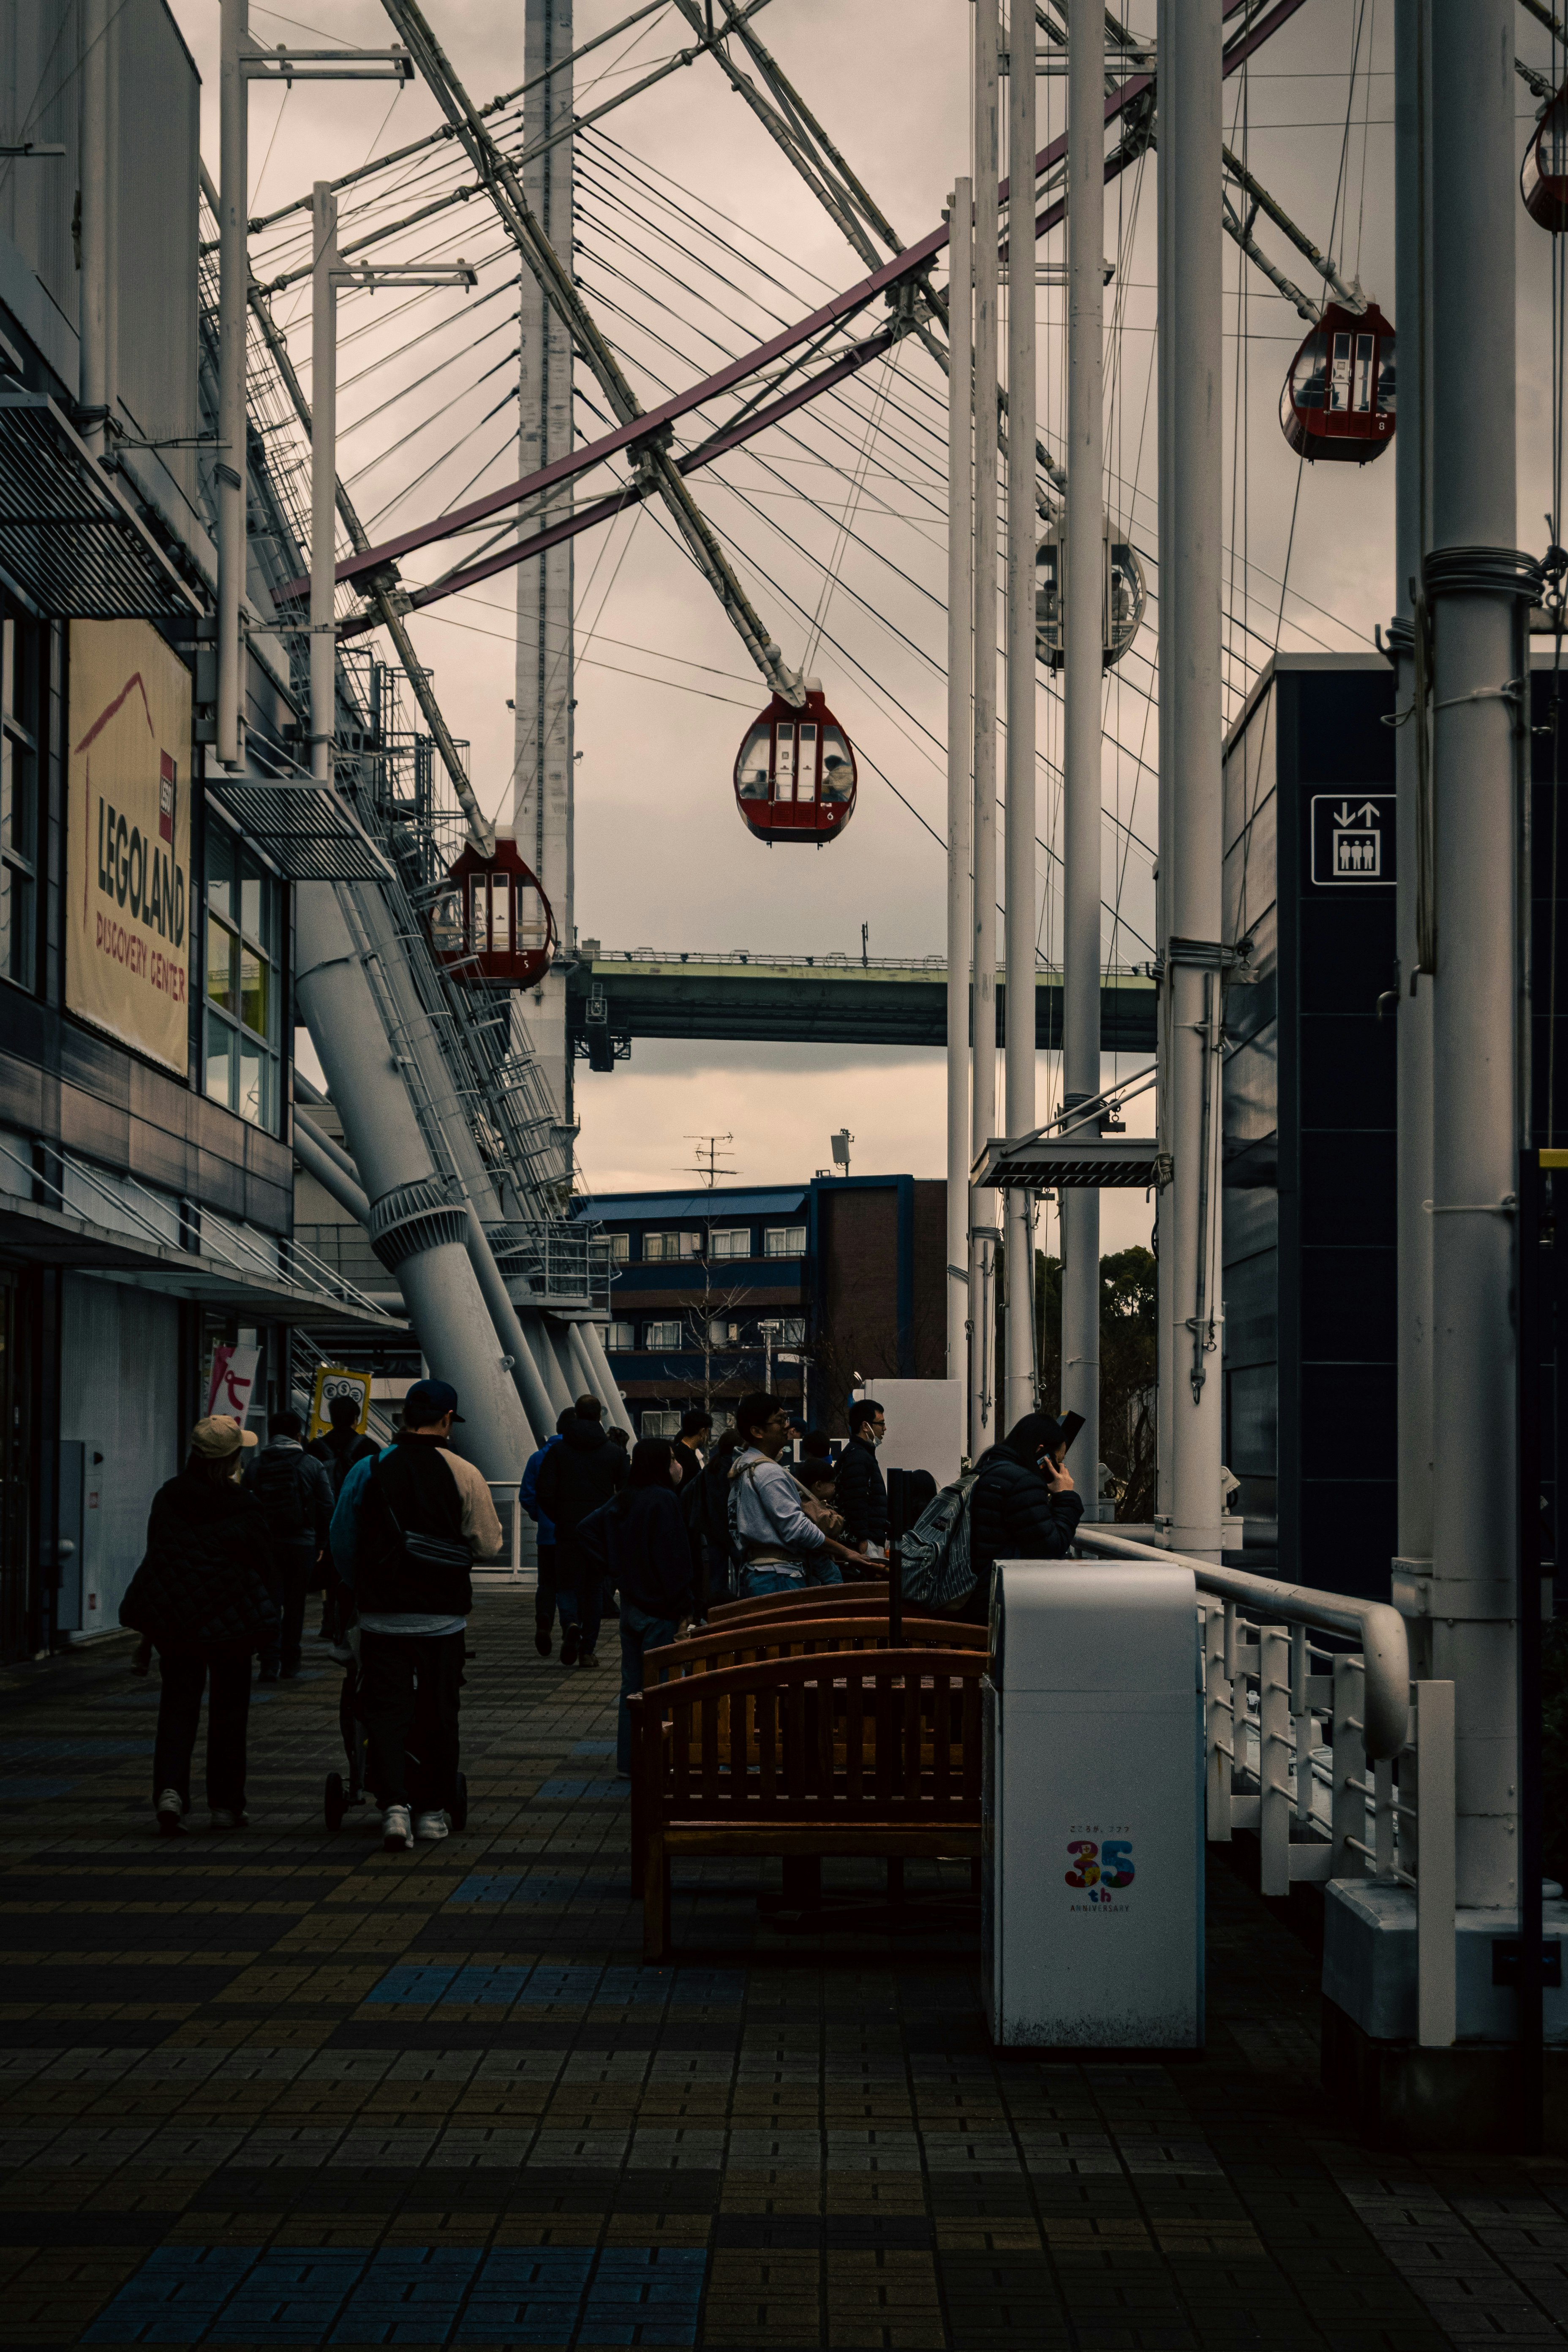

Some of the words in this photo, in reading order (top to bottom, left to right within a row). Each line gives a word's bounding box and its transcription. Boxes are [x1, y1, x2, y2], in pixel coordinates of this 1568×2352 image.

[1379, 422, 1385, 430] 8
[827, 811, 834, 820] 6
[98, 796, 184, 948] LEGOLAND
[96, 910, 147, 979] DISCOVERY
[150, 950, 185, 1004] CENTER
[524, 960, 529, 968] 5
[1064, 1840, 1135, 1888] 35
[1088, 1887, 1111, 1902] th
